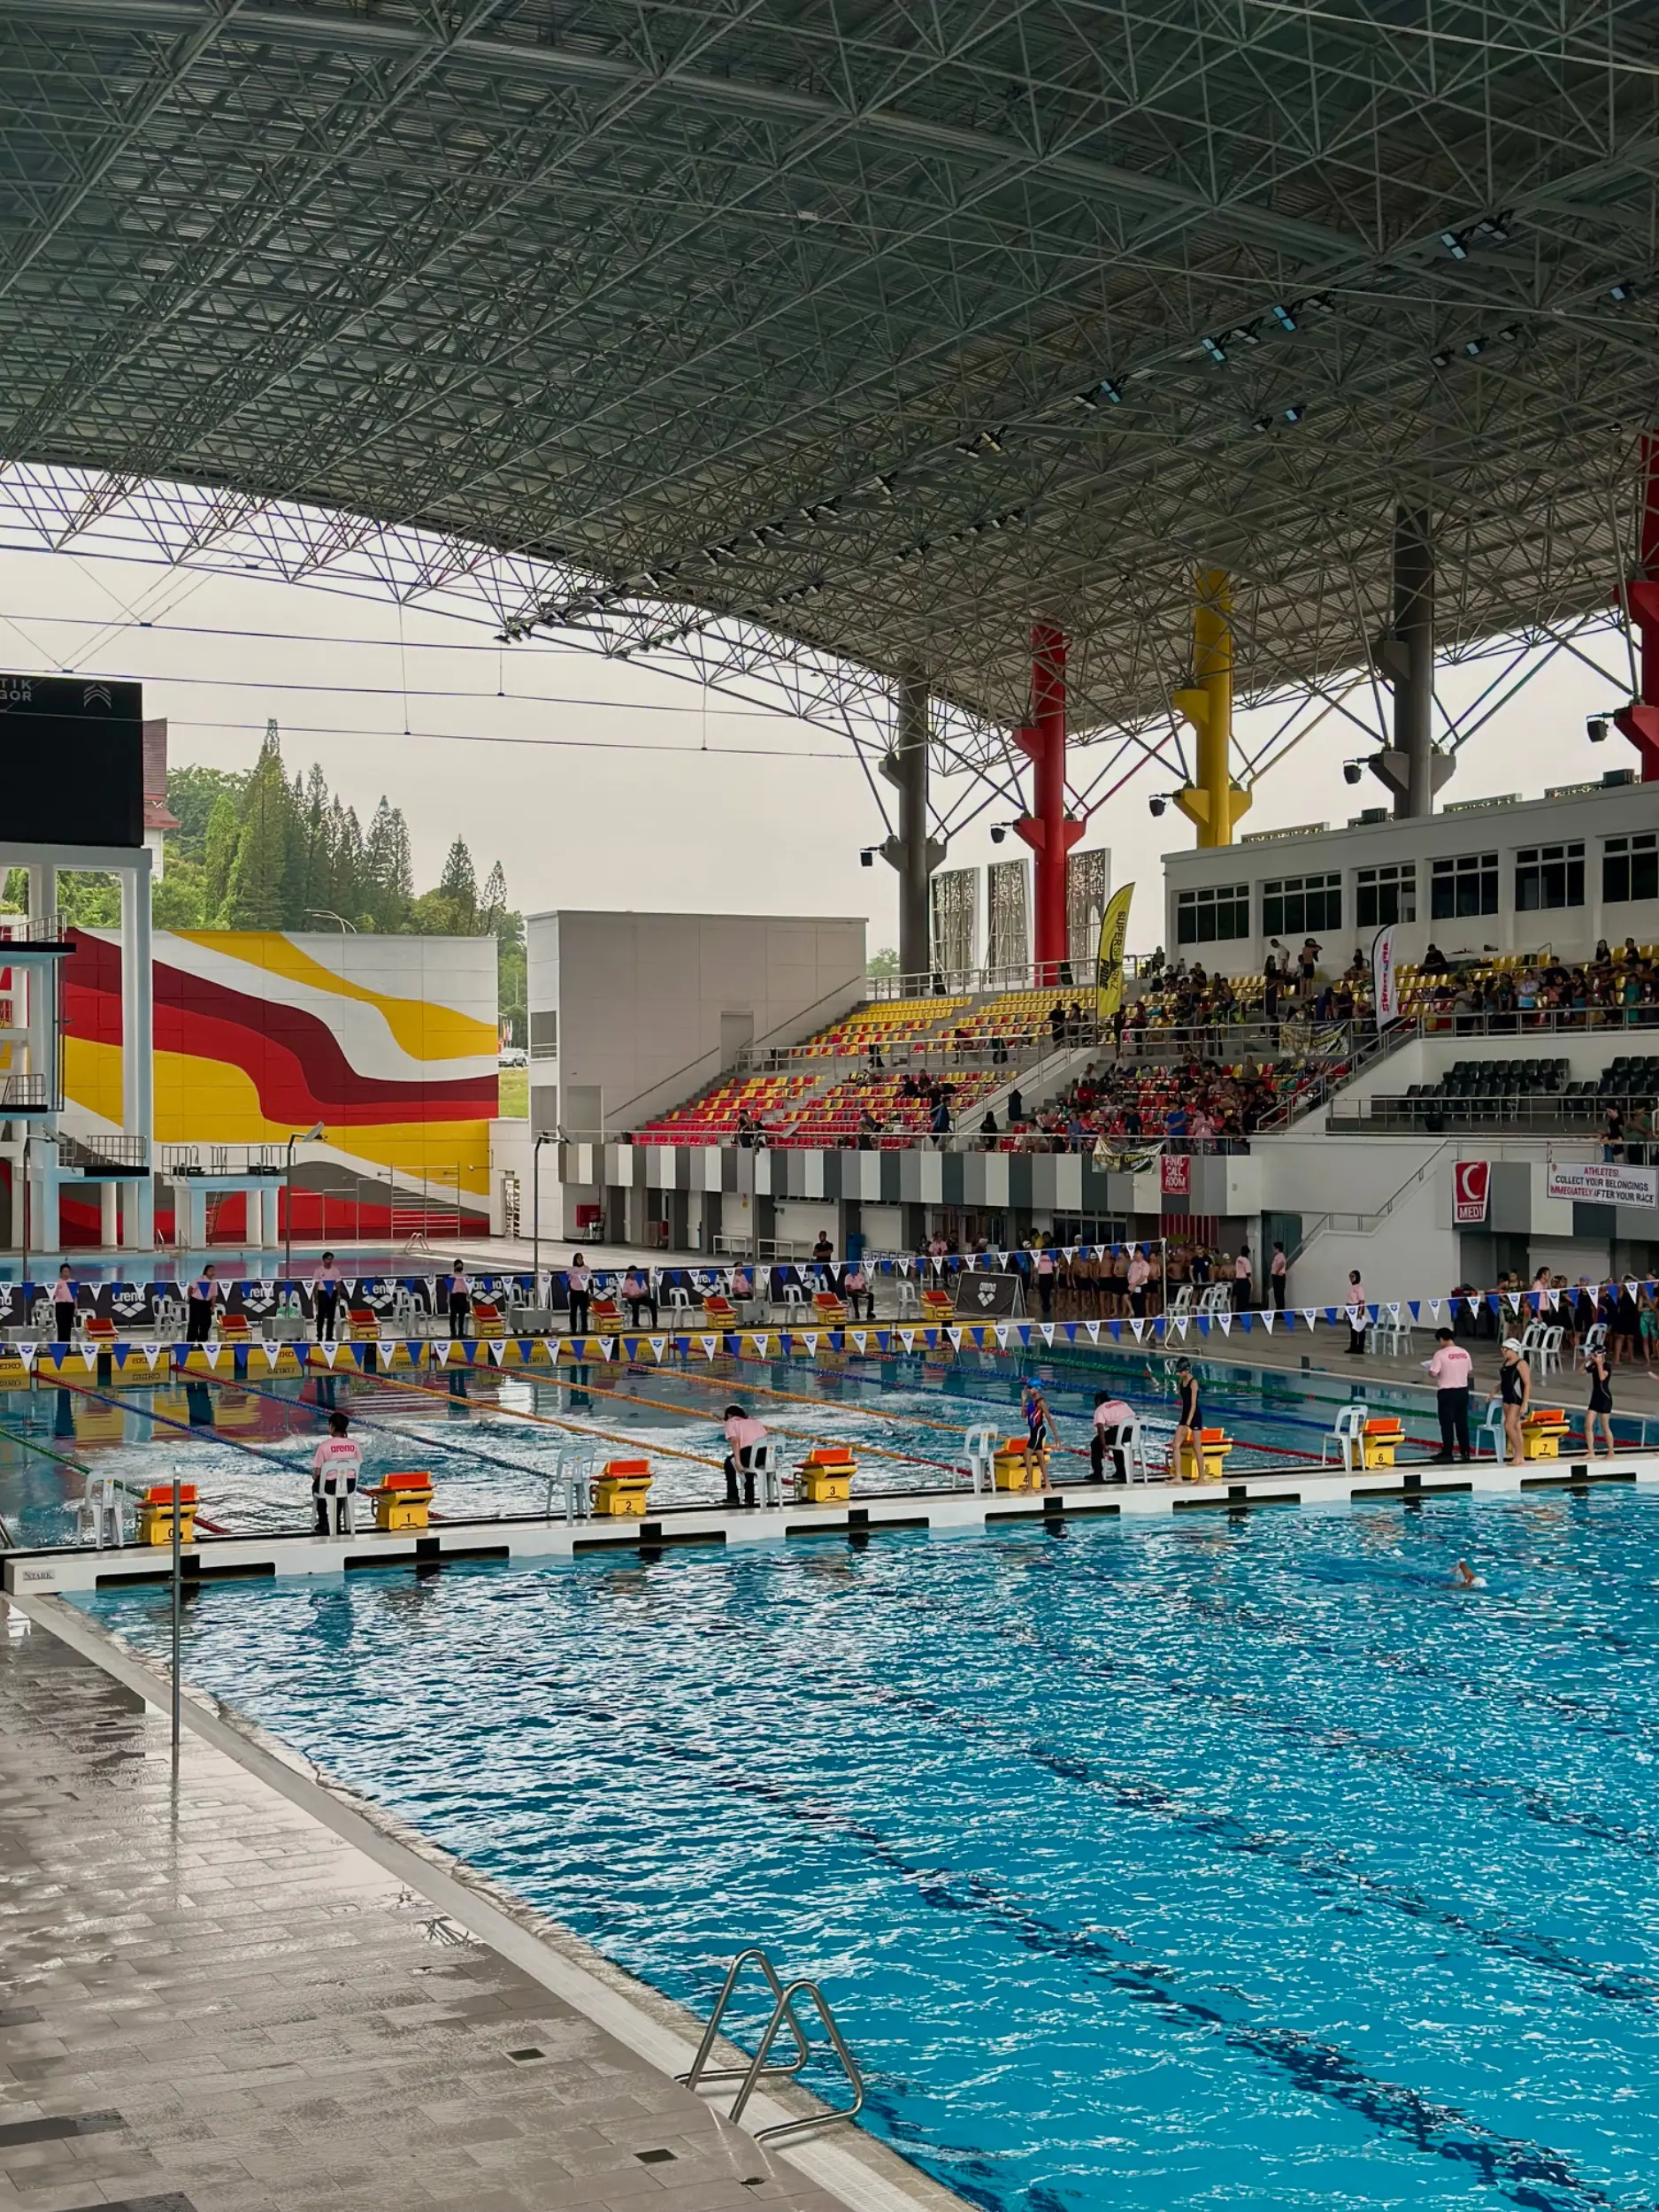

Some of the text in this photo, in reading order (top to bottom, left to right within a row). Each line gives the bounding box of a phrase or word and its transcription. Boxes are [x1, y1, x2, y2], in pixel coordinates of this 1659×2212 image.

[1555, 1175, 1648, 1192] COLLECT YOUR BELONGINGS
[1550, 1186, 1593, 1197] IMMEDIATELY
[1617, 1192, 1634, 1202] YOUR
[1636, 1194, 1655, 1203] RACE
[331, 1444, 355, 1453] arena
[1378, 1453, 1384, 1462] 6
[829, 1486, 836, 1496] 3
[626, 1500, 633, 1510] 2
[406, 1512, 411, 1523] 1
